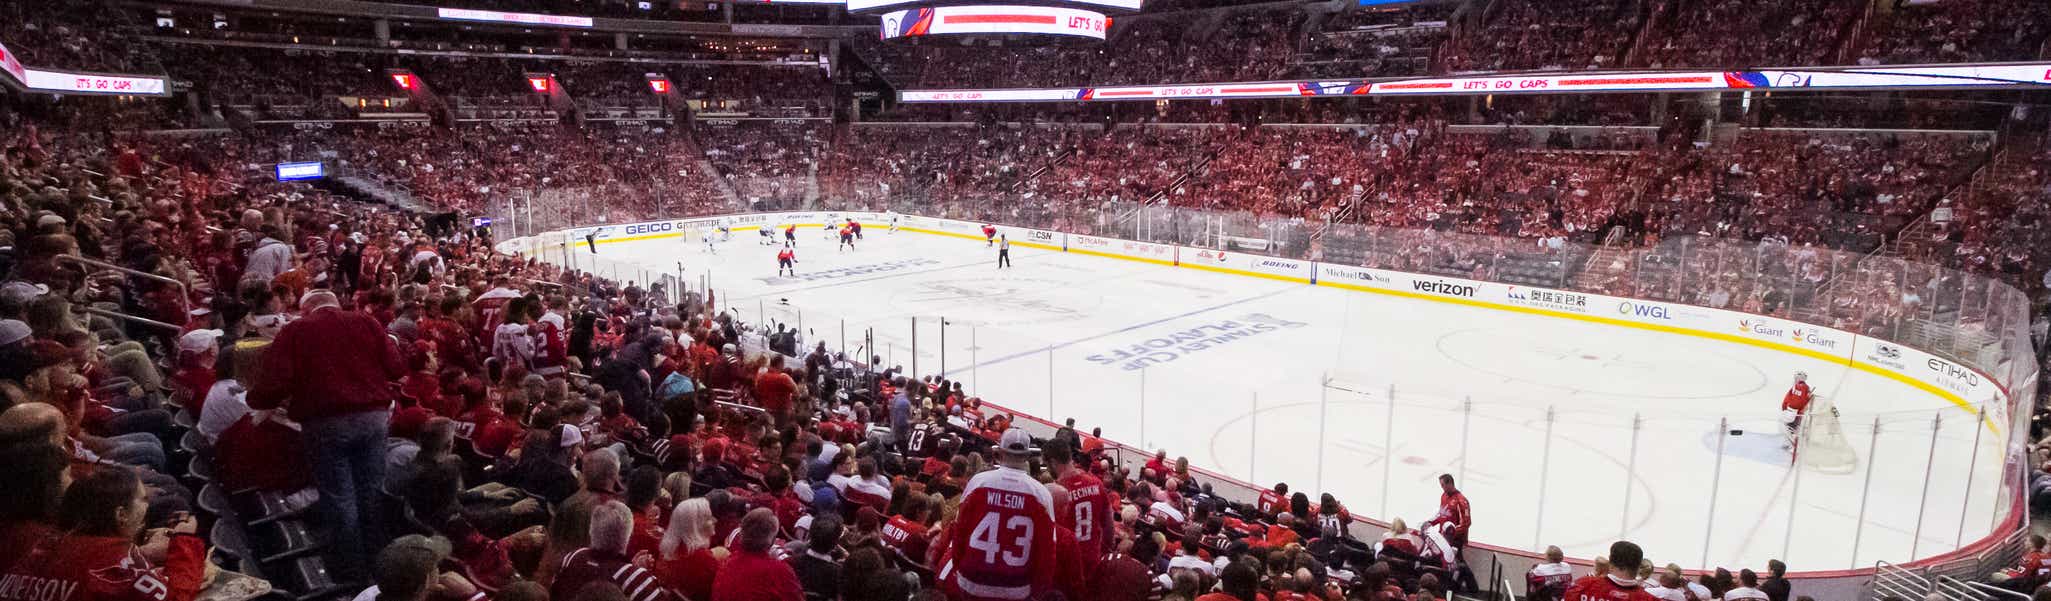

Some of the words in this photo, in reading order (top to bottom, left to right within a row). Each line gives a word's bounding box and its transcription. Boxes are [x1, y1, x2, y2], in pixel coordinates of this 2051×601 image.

[1068, 16, 1090, 30] LET'S
[96, 80, 108, 89] GO
[113, 80, 131, 90] CAPS
[1463, 80, 1488, 89] LET'S
[1495, 80, 1512, 88] GO
[1520, 79, 1548, 88] CAPS
[626, 222, 672, 235] GEICO
[1036, 231, 1052, 240] CSN
[1262, 260, 1298, 270] BOEING
[1326, 268, 1357, 280] Michael
[1374, 274, 1390, 283] Son
[1413, 279, 1474, 297] verizon
[1634, 303, 1671, 320] WGL
[1178, 322, 1278, 354] STANLEY
[1753, 323, 1784, 338] Giant
[1085, 319, 1244, 365] PLAYOFFS
[1806, 333, 1838, 349] Giant
[1122, 350, 1179, 371] CUP
[1928, 358, 1978, 387] ETIHAD
[908, 430, 925, 451] 13
[987, 491, 1025, 510] WILSON
[1068, 485, 1101, 500] VECHKIN
[1075, 501, 1093, 542] 8
[969, 511, 1034, 567] 43
